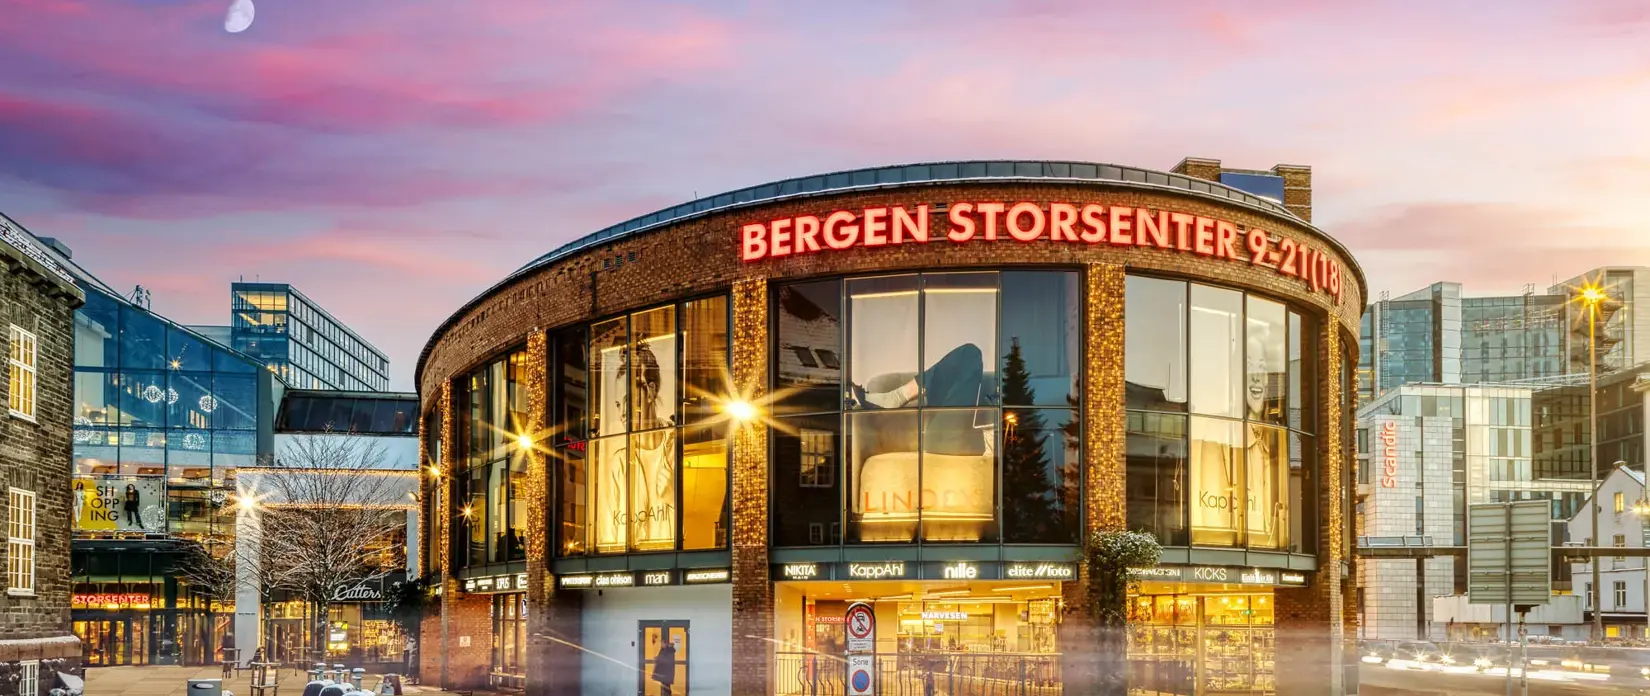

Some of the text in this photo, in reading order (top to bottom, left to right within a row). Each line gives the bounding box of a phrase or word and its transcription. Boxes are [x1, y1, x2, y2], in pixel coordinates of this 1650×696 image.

[742, 201, 1342, 305] BERGEN STORSENTER 9-21(18)
[1381, 419, 1397, 489] Scandic
[96, 485, 114, 497] SH
[90, 498, 120, 509] OPP
[1199, 490, 1256, 514] Kaphl
[90, 510, 119, 521] ING
[850, 563, 904, 579] KappAhl
[944, 562, 977, 579] nille
[1194, 567, 1227, 581] KICKS
[645, 572, 670, 585] mani
[331, 584, 382, 601] Cutters
[73, 594, 149, 605] STORSENTER
[922, 611, 968, 620] NARVESEN
[852, 658, 869, 667] Sone
